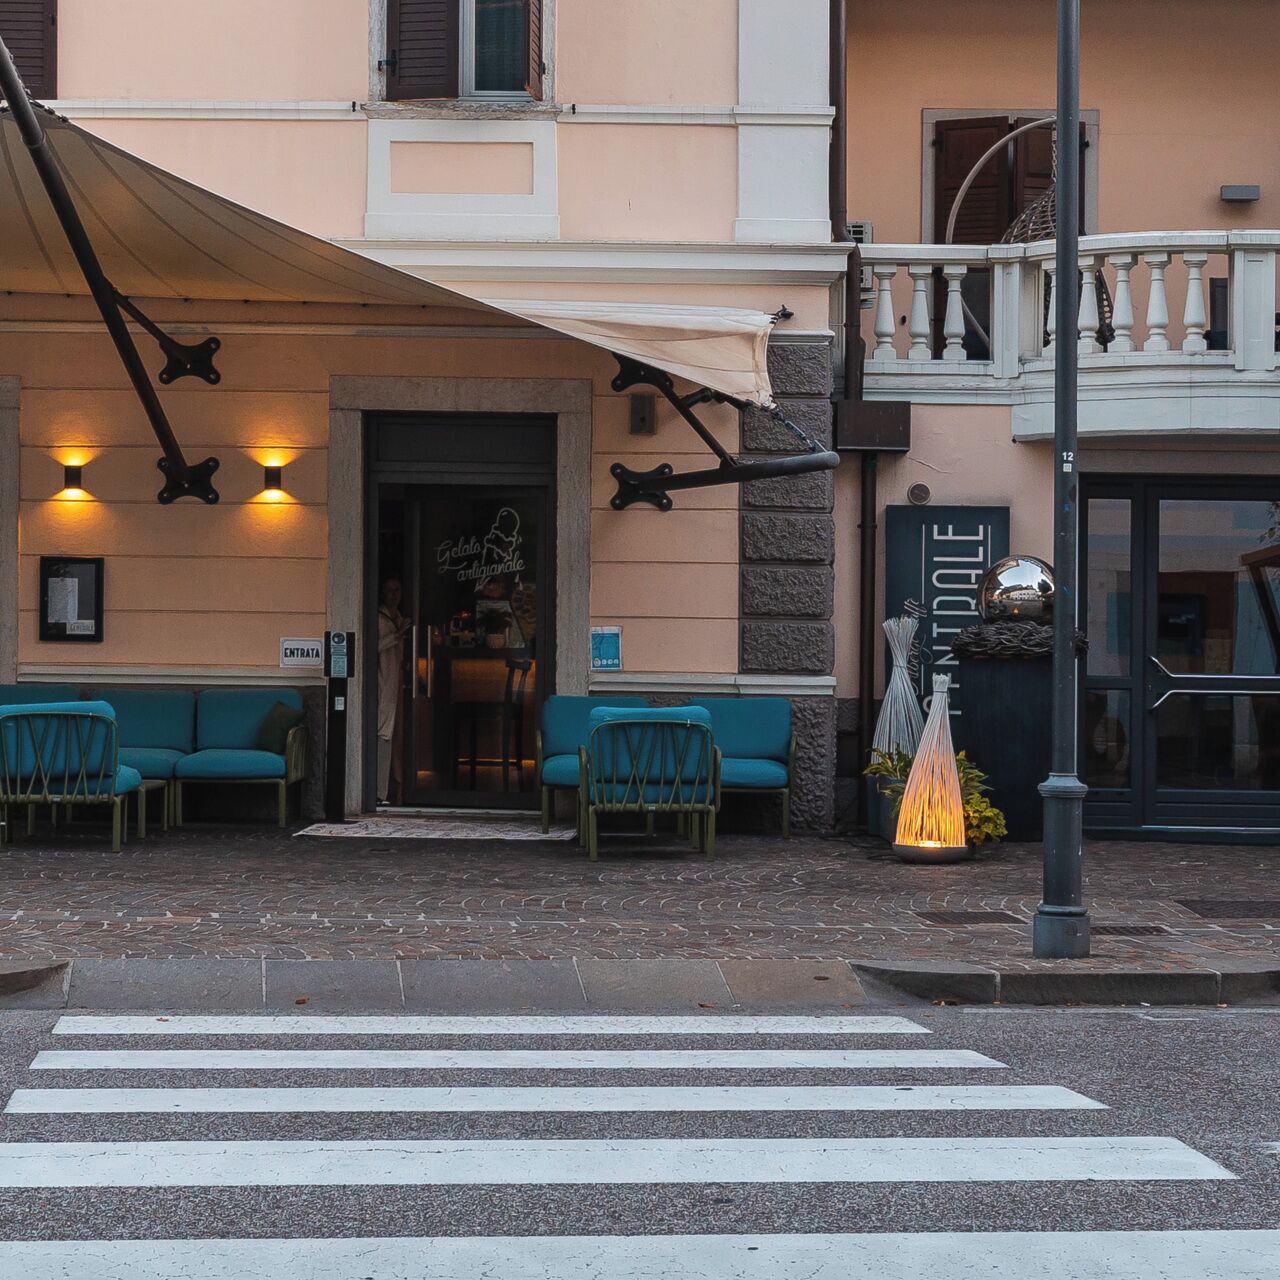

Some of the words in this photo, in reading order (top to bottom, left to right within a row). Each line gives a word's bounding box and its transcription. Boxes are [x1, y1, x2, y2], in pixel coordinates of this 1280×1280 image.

[1062, 451, 1074, 461] 12
[433, 536, 481, 574] Gelato
[923, 524, 984, 716] NTRALE
[284, 647, 320, 658] ENTRATA
